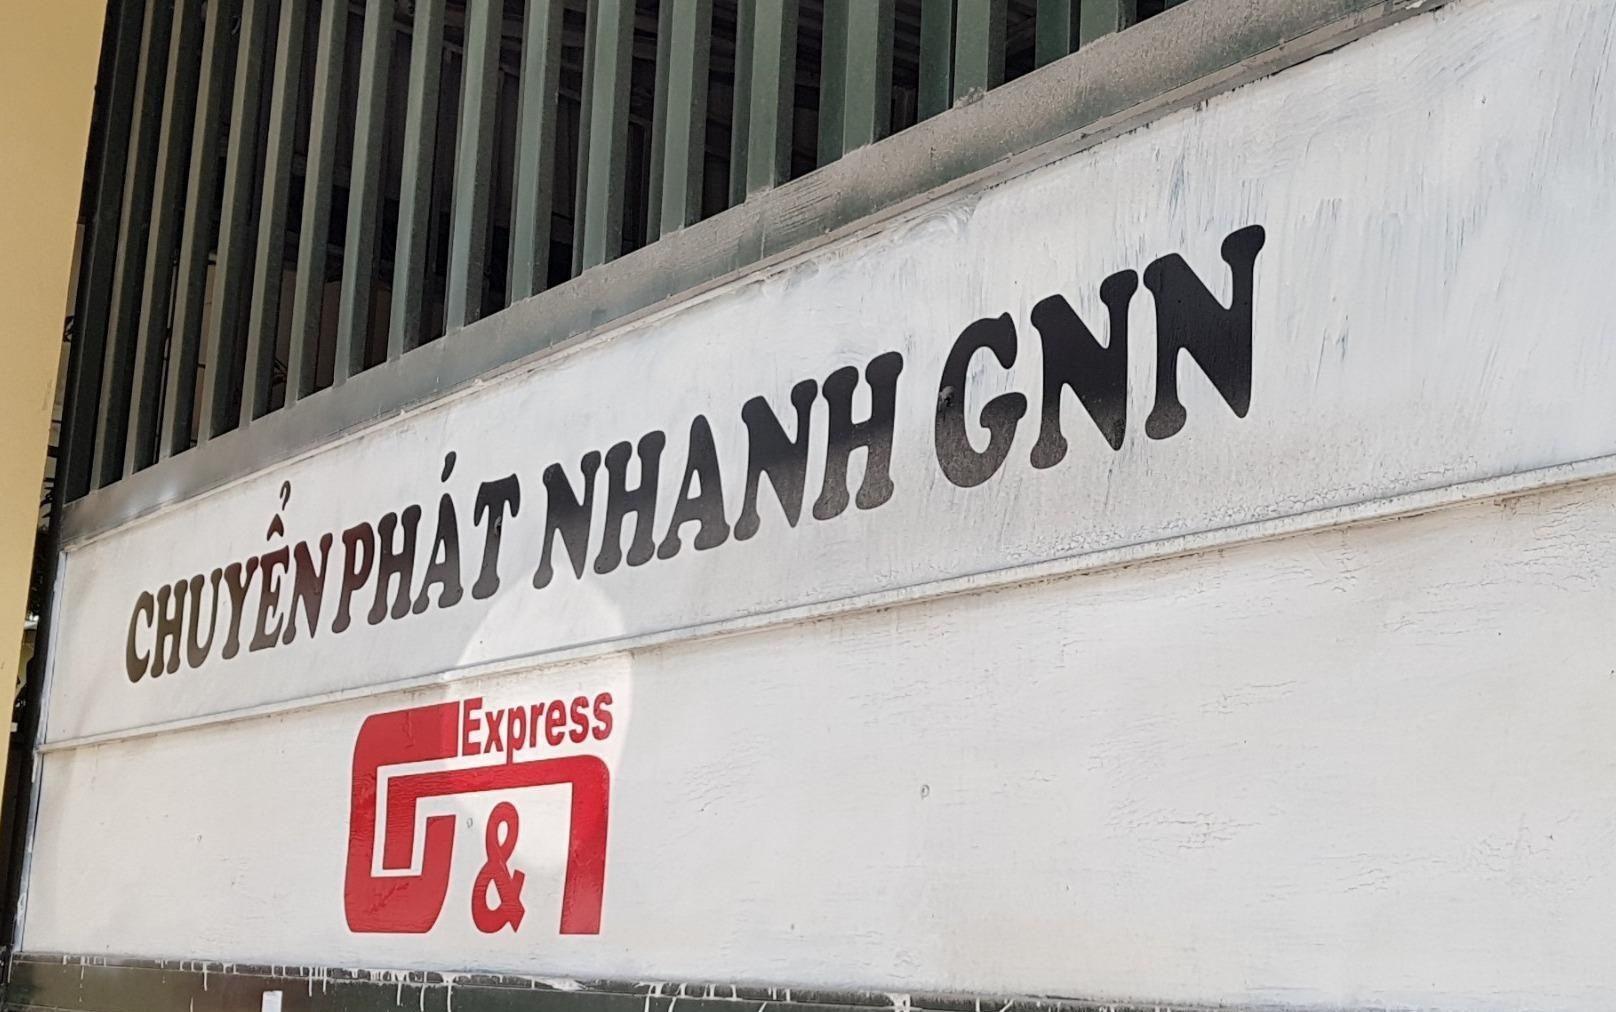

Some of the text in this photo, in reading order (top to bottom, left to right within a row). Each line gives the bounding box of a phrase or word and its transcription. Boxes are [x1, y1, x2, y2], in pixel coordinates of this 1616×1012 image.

[126, 224, 1266, 684] CHUYỂN PHÁT NHANH GNN
[462, 691, 614, 766] Express
